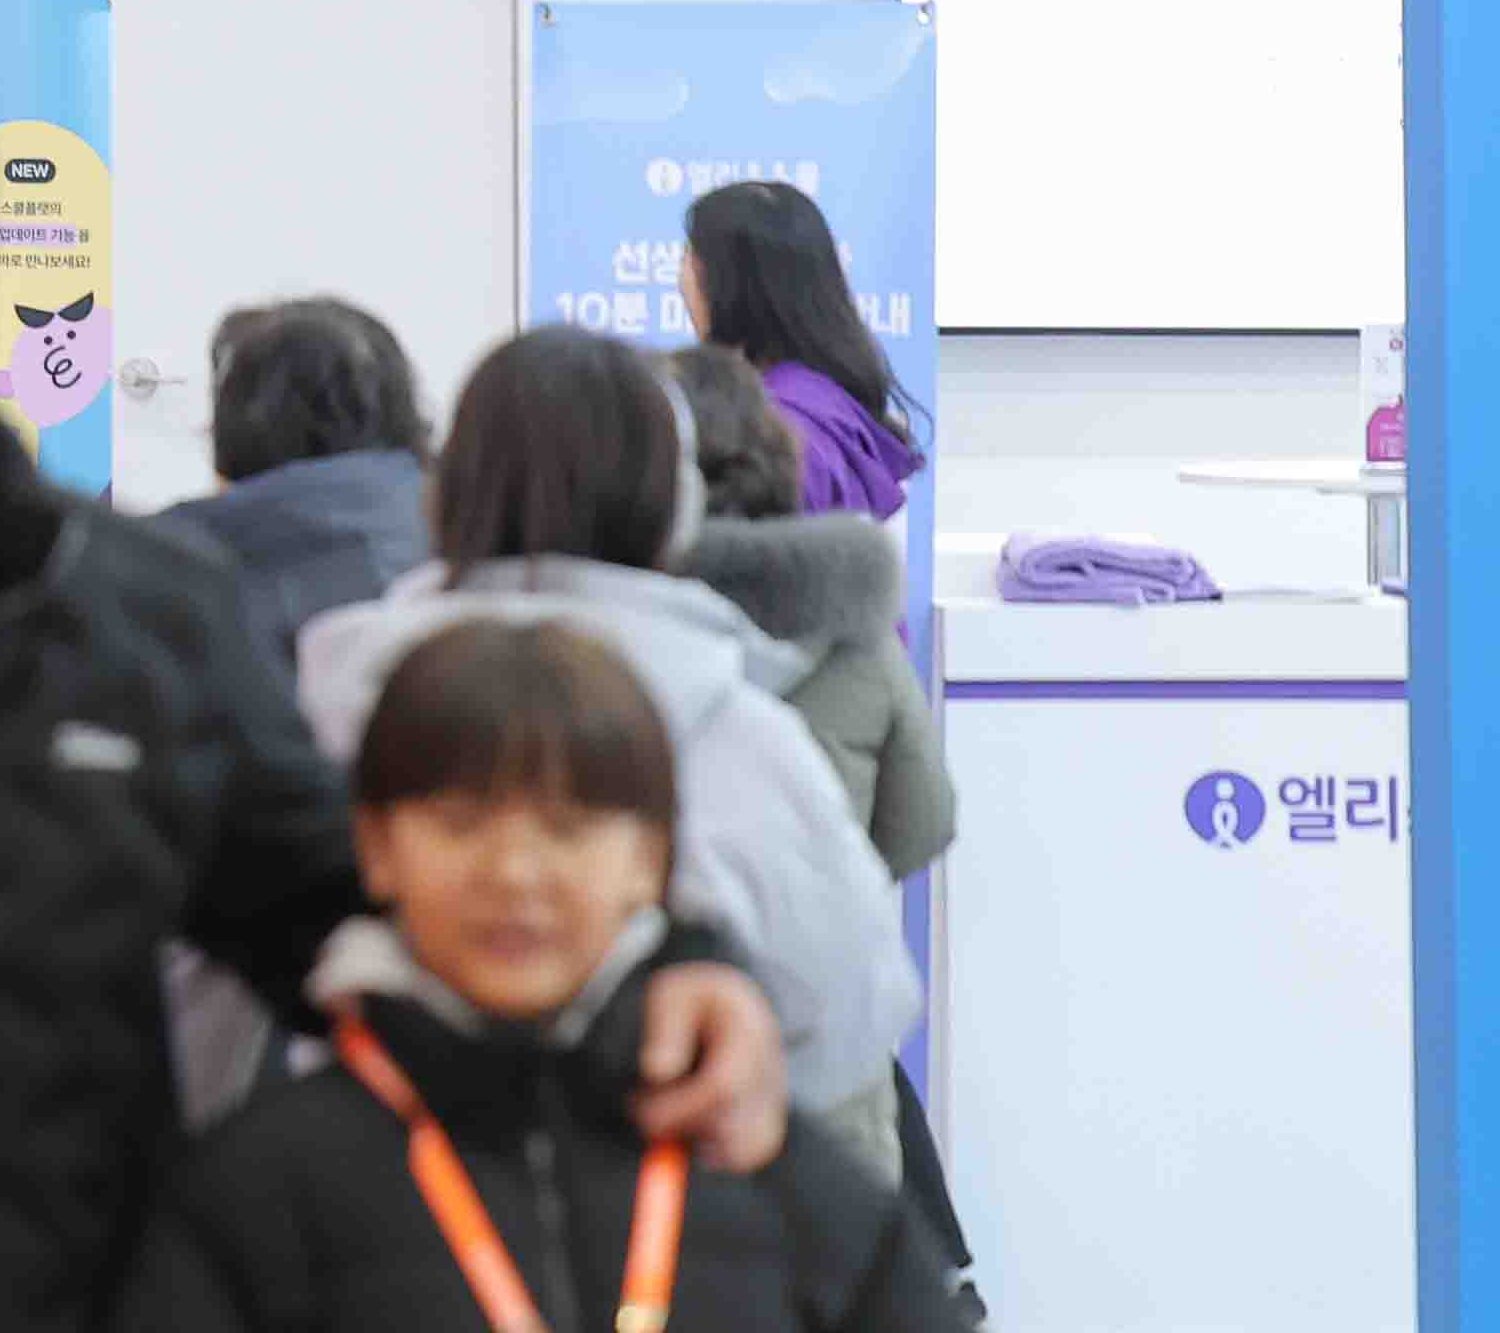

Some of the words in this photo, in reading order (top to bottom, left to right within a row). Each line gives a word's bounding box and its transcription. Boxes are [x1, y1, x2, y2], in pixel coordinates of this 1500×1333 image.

[11, 163, 50, 178] NEW
[614, 241, 684, 283] 선생
[1278, 776, 1409, 841] 엘리
